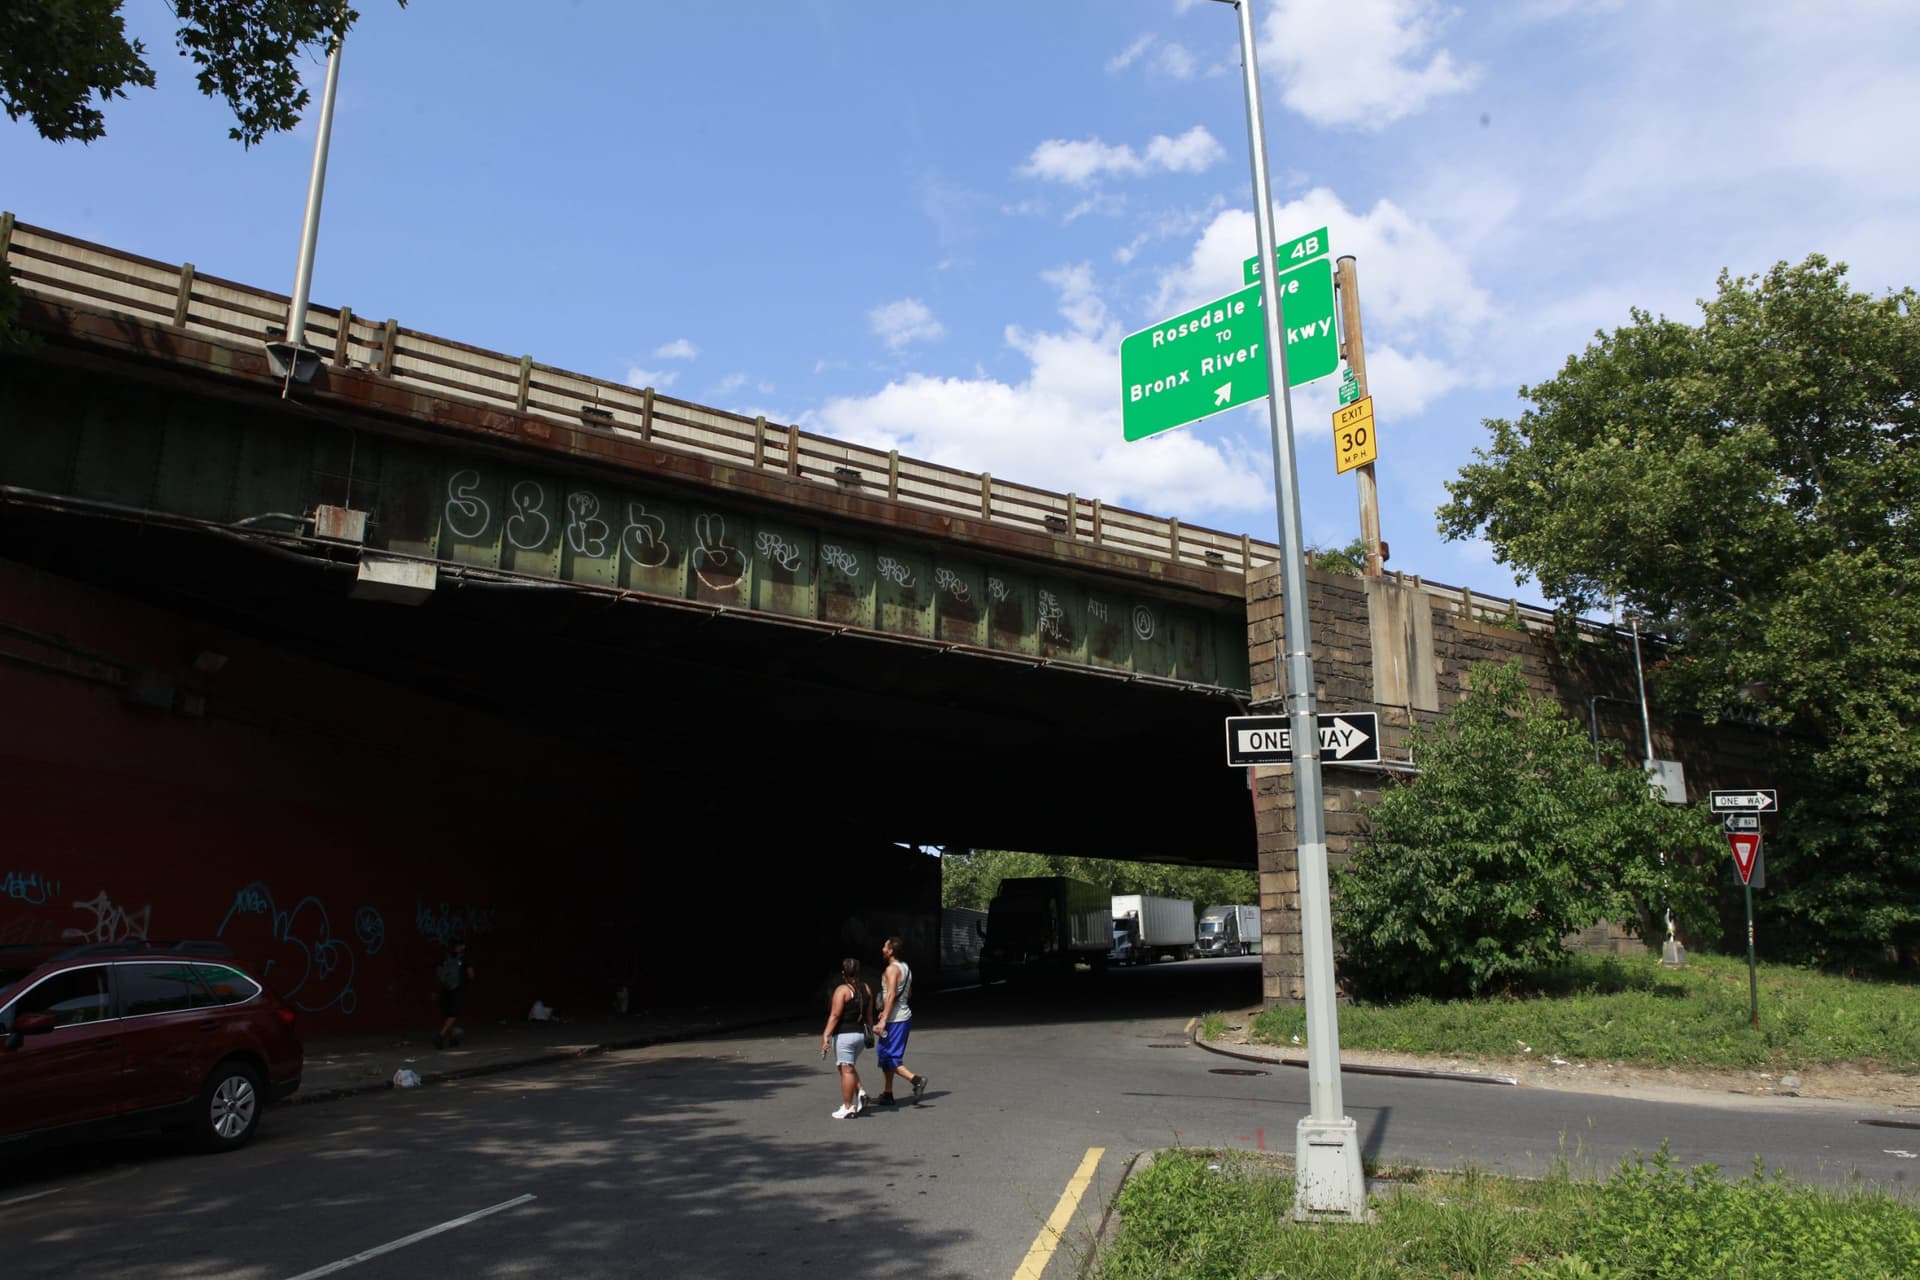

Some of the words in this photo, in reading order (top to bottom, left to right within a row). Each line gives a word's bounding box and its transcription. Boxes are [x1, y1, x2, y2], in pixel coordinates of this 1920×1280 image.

[1291, 236, 1319, 259] 4B
[1152, 300, 1245, 348] Rosedale
[1257, 279, 1300, 308] ve
[1216, 329, 1232, 344] TO
[1130, 368, 1190, 402] Bronx
[1201, 343, 1260, 377] River
[1286, 316, 1333, 345] kwy
[1342, 405, 1363, 423] EXIT
[1342, 427, 1367, 452] 30
[1250, 731, 1291, 750] ONE
[1720, 797, 1740, 806] ONE
[1747, 796, 1766, 805] WAY
